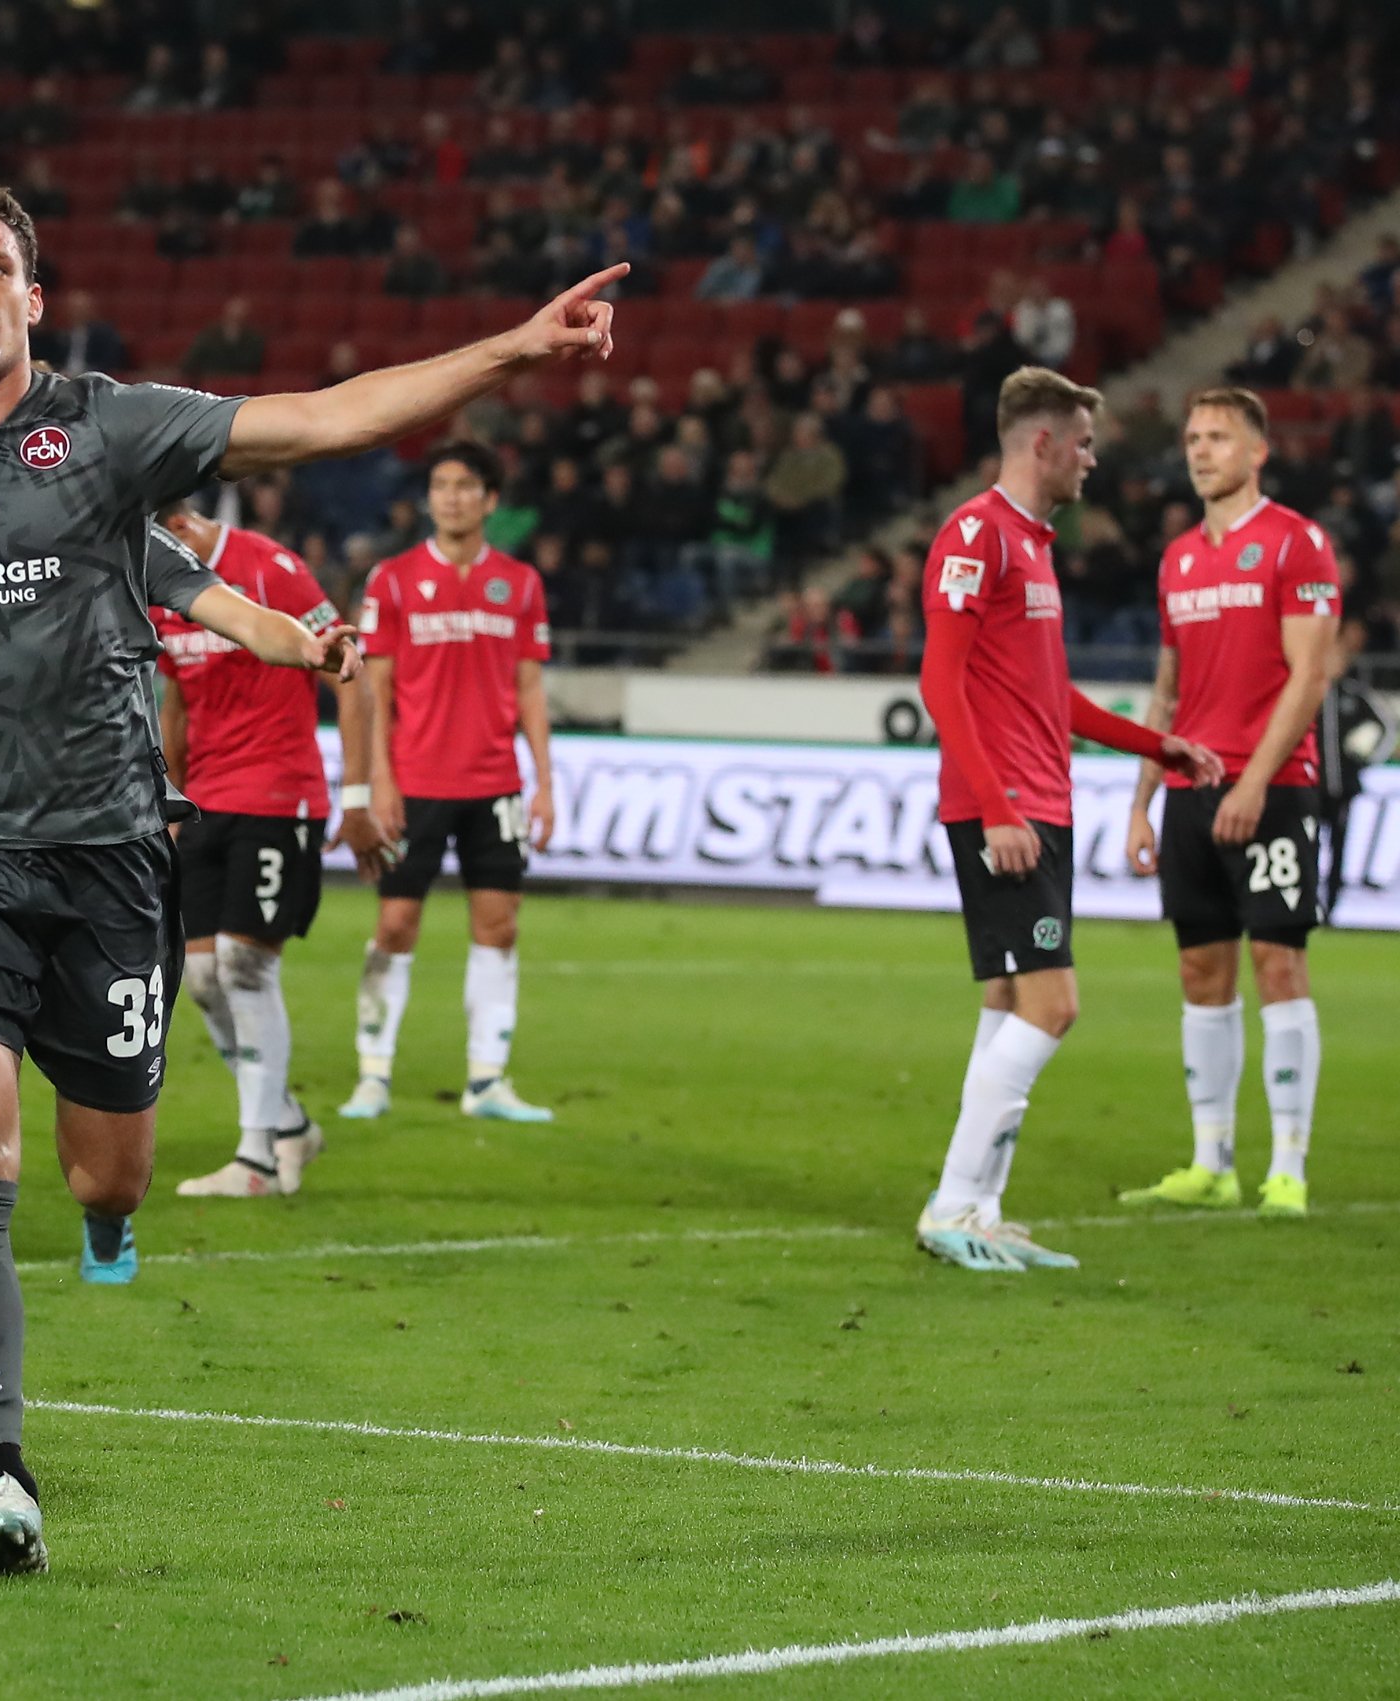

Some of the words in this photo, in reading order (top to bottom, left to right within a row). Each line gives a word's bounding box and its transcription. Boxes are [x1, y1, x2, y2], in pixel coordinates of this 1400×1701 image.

[26, 441, 65, 461] FCN
[255, 847, 285, 899] 3
[1246, 836, 1300, 893] 28
[106, 964, 164, 1058] 33
